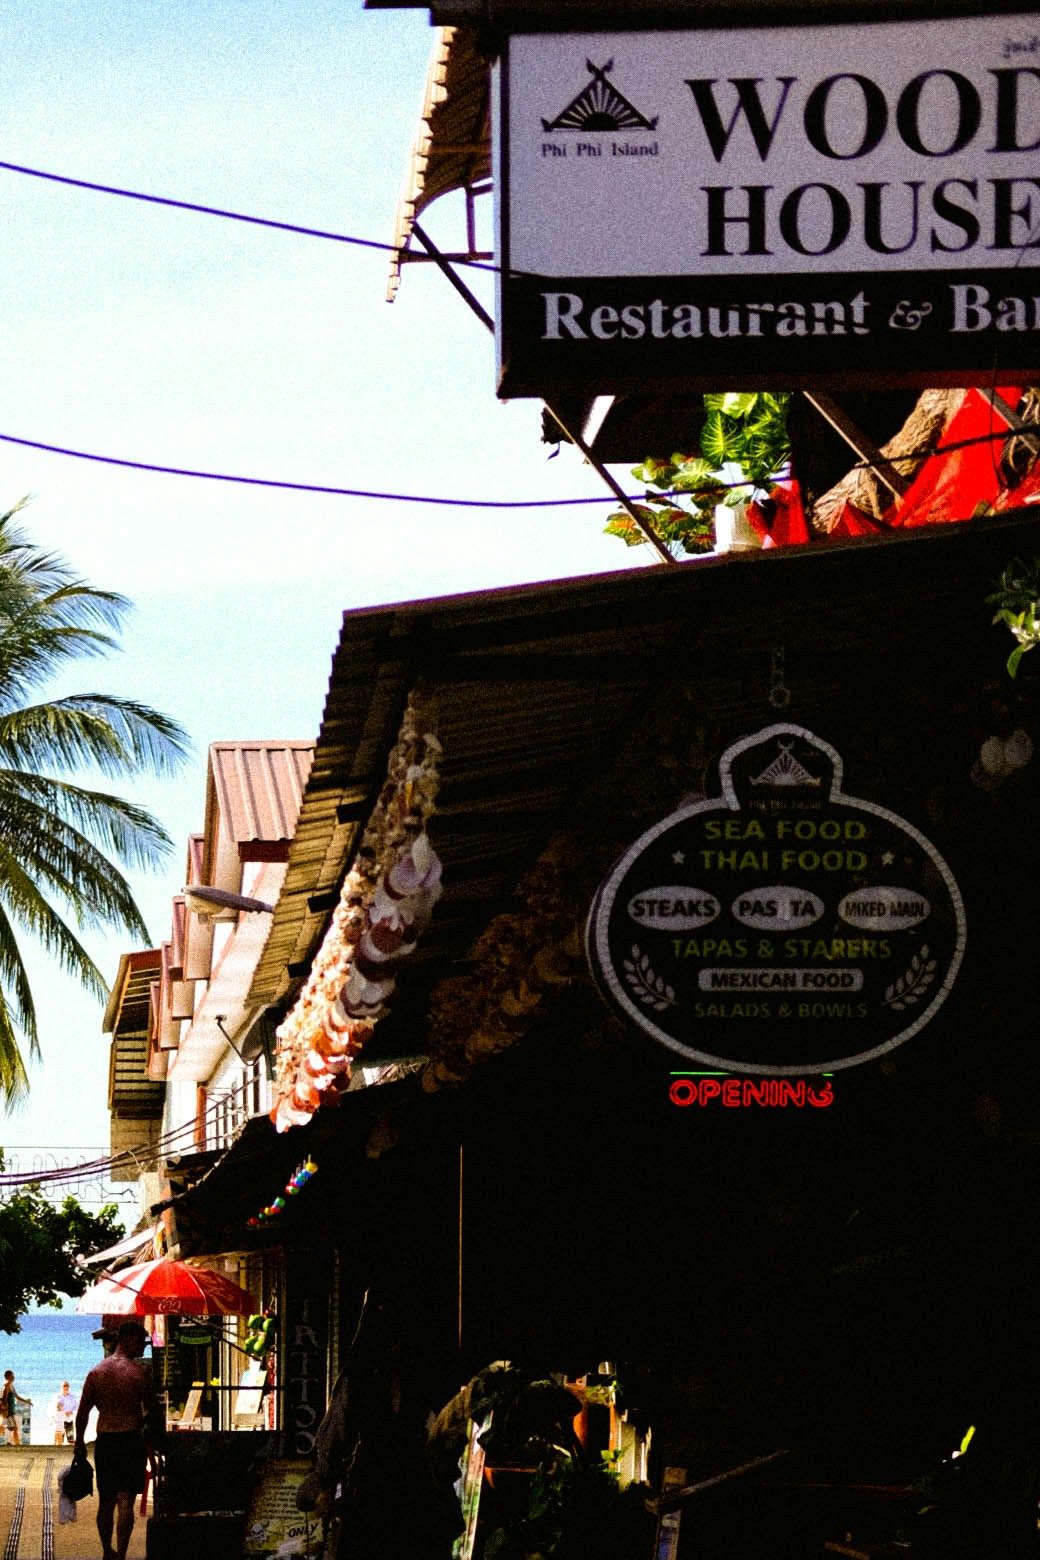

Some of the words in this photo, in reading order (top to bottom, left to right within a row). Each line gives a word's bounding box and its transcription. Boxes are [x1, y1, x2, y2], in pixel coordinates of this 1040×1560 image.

[685, 67, 1040, 163] WOOD
[541, 142, 567, 158] Phi
[576, 142, 602, 158] Phi
[612, 141, 659, 157] Island
[699, 177, 1040, 256] HOUSE
[539, 290, 870, 340] Restaurant
[889, 300, 933, 330] &
[949, 281, 1040, 332] Ba
[705, 820, 764, 841] SEA
[777, 820, 867, 841] FOOD
[699, 849, 769, 871] THAI
[781, 849, 868, 871] FOOD
[632, 899, 717, 918] STEAKS
[671, 938, 748, 959] TAPAS
[759, 938, 775, 959] &
[710, 972, 798, 988] MEXICAN
[801, 972, 855, 988] FOOD
[694, 1002, 772, 1019] SALADS
[778, 1002, 793, 1018] &
[798, 1002, 868, 1019] BOWLS
[668, 1079, 834, 1107] OPENING
